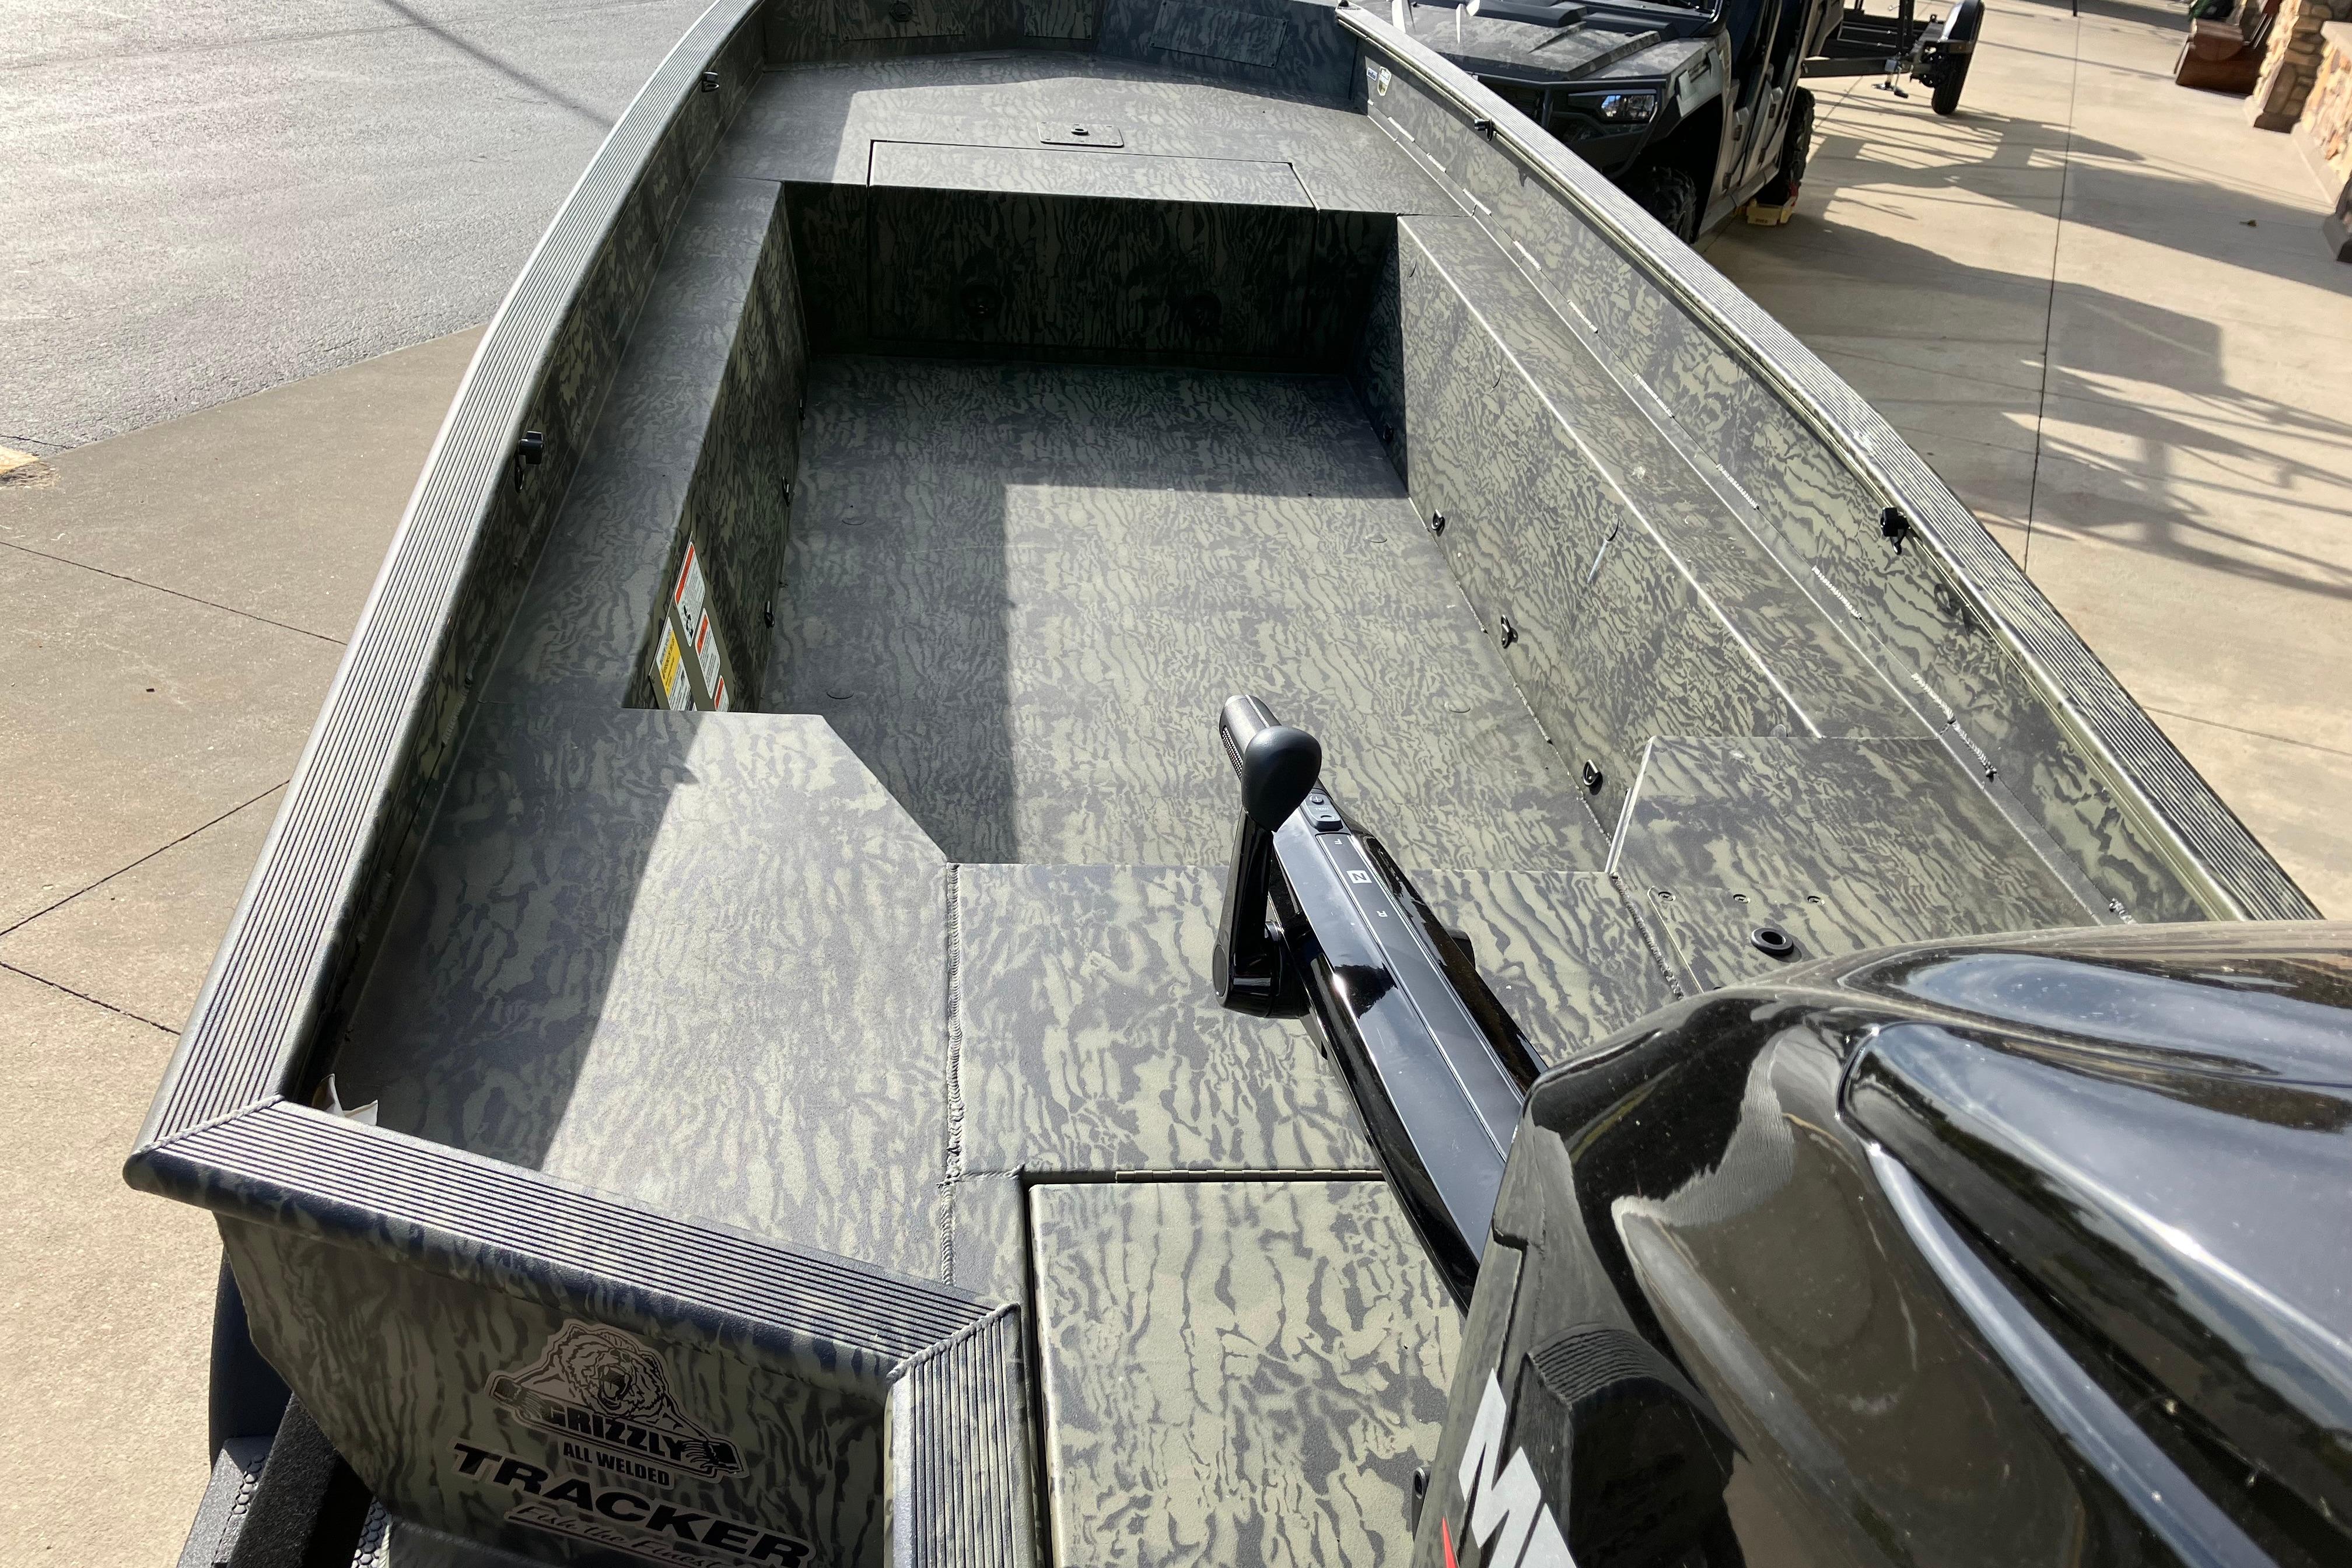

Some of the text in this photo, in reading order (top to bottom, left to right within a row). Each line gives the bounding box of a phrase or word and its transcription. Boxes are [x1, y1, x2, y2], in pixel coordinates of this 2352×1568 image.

[542, 1400, 685, 1462] GRIZZLY
[564, 1442, 670, 1486] ALL WELDED
[453, 1443, 811, 1568] TRACKER
[579, 1523, 629, 1544] the
